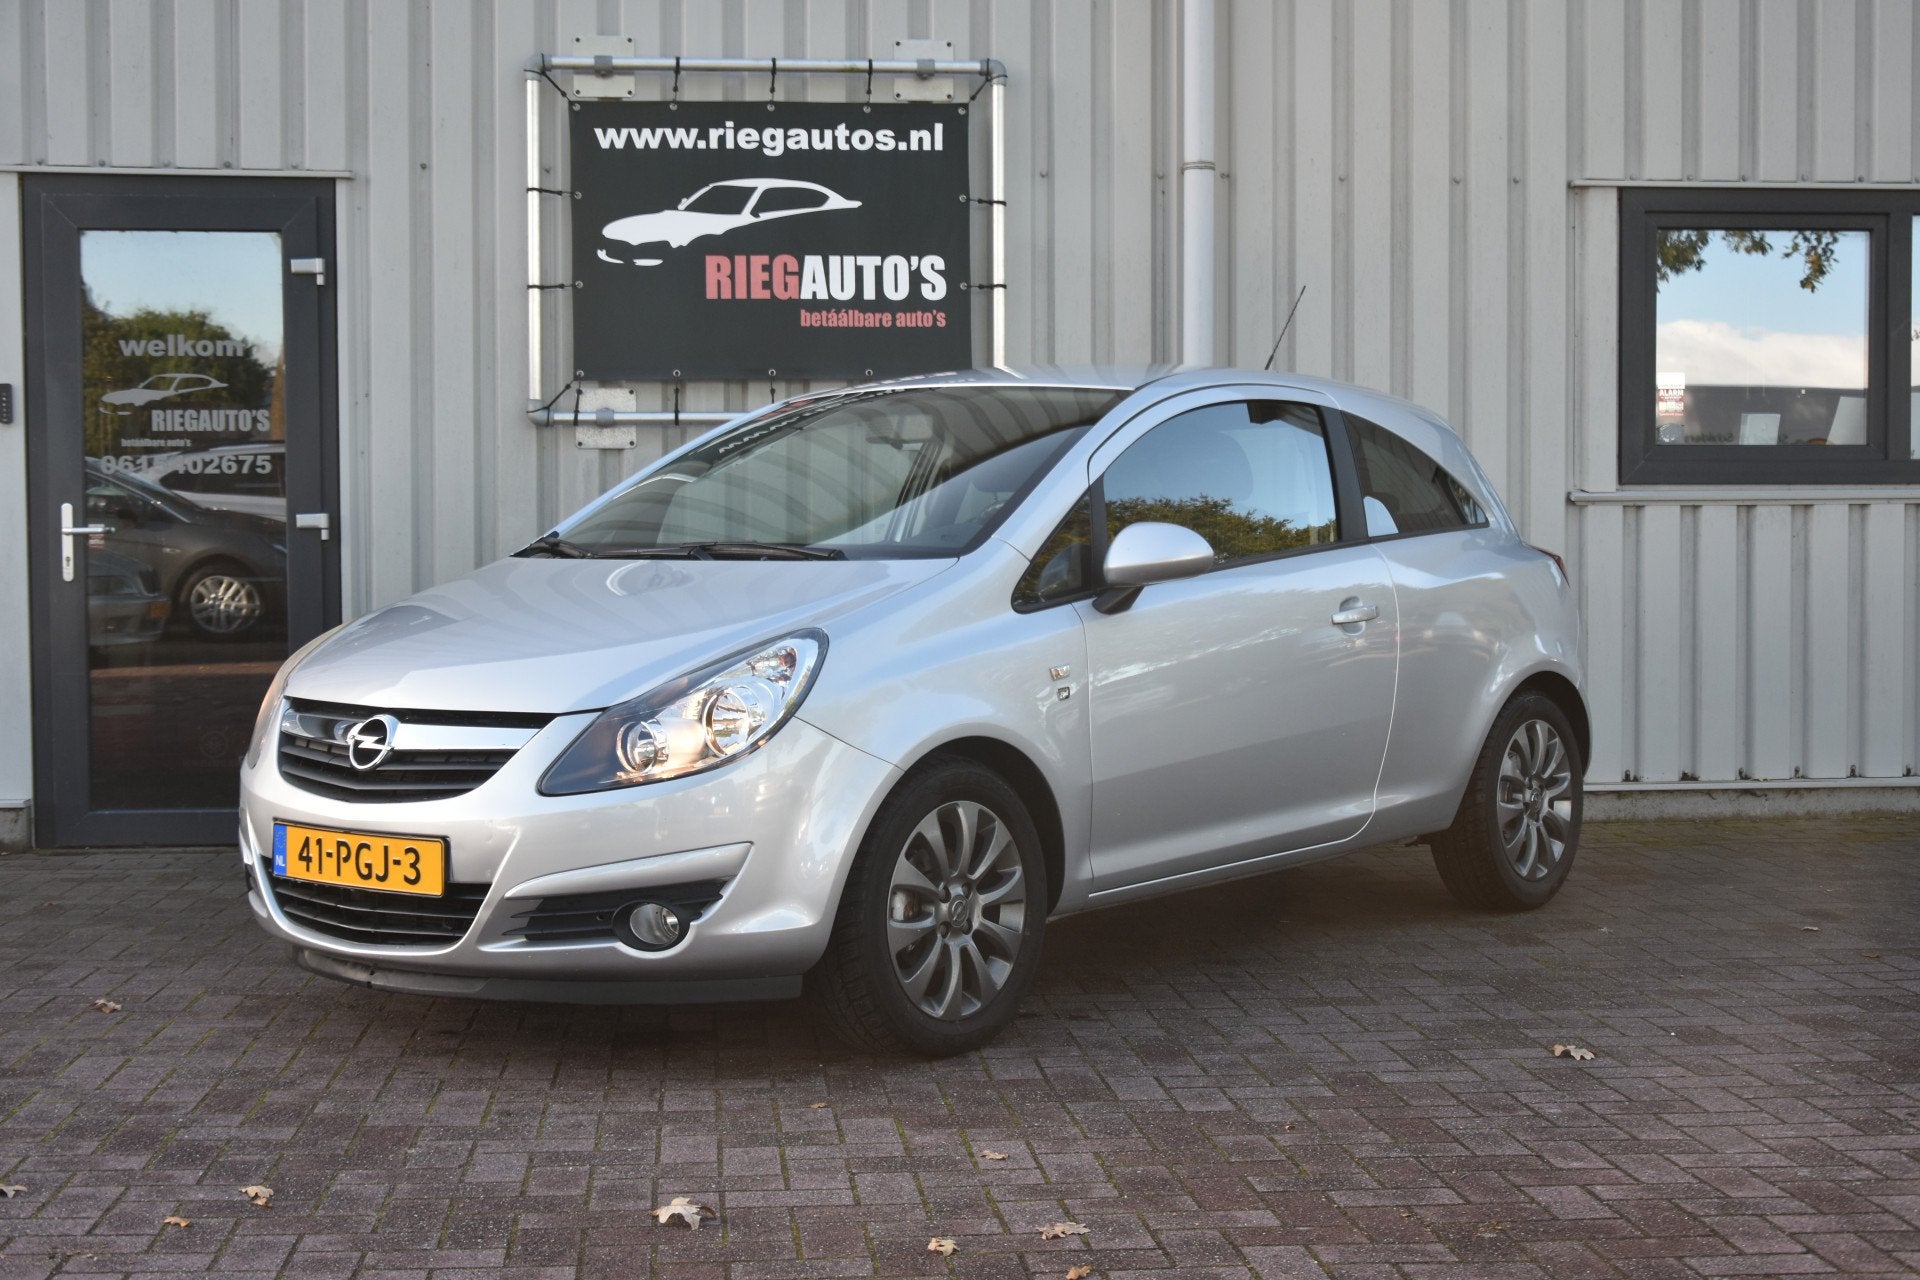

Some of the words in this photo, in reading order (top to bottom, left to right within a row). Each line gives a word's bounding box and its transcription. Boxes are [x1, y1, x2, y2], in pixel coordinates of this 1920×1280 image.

[594, 121, 944, 157] www.riegautos.nl
[705, 254, 947, 301] RIEGAUTO'S
[800, 309, 892, 328] betáálbare
[895, 309, 947, 328] auto's
[118, 334, 246, 357] welkom
[1658, 389, 1684, 397] ALARM
[151, 409, 271, 432] RIEGAUTO'S
[275, 855, 286, 867] NL
[298, 836, 421, 886] 41-PGJ-3
